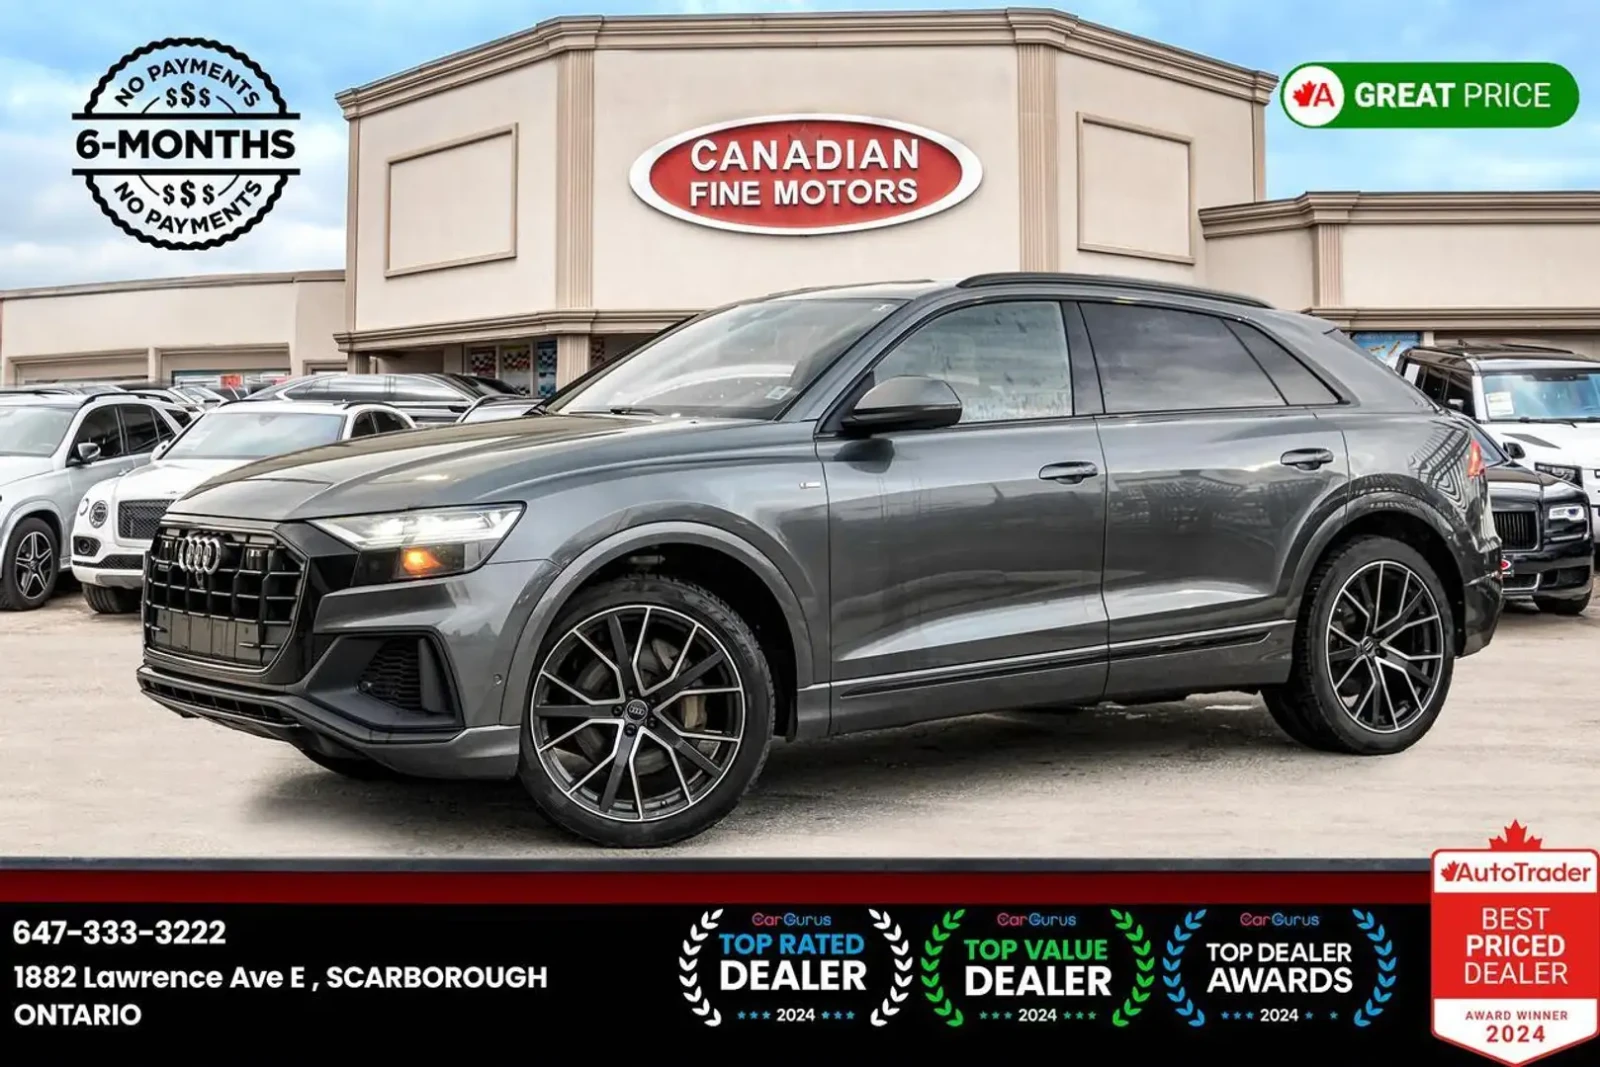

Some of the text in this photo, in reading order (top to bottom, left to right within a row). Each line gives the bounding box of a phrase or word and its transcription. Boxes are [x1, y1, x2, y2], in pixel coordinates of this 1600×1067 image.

[690, 139, 919, 172] CANADIAN
[690, 178, 918, 207] FINE MOTORS
